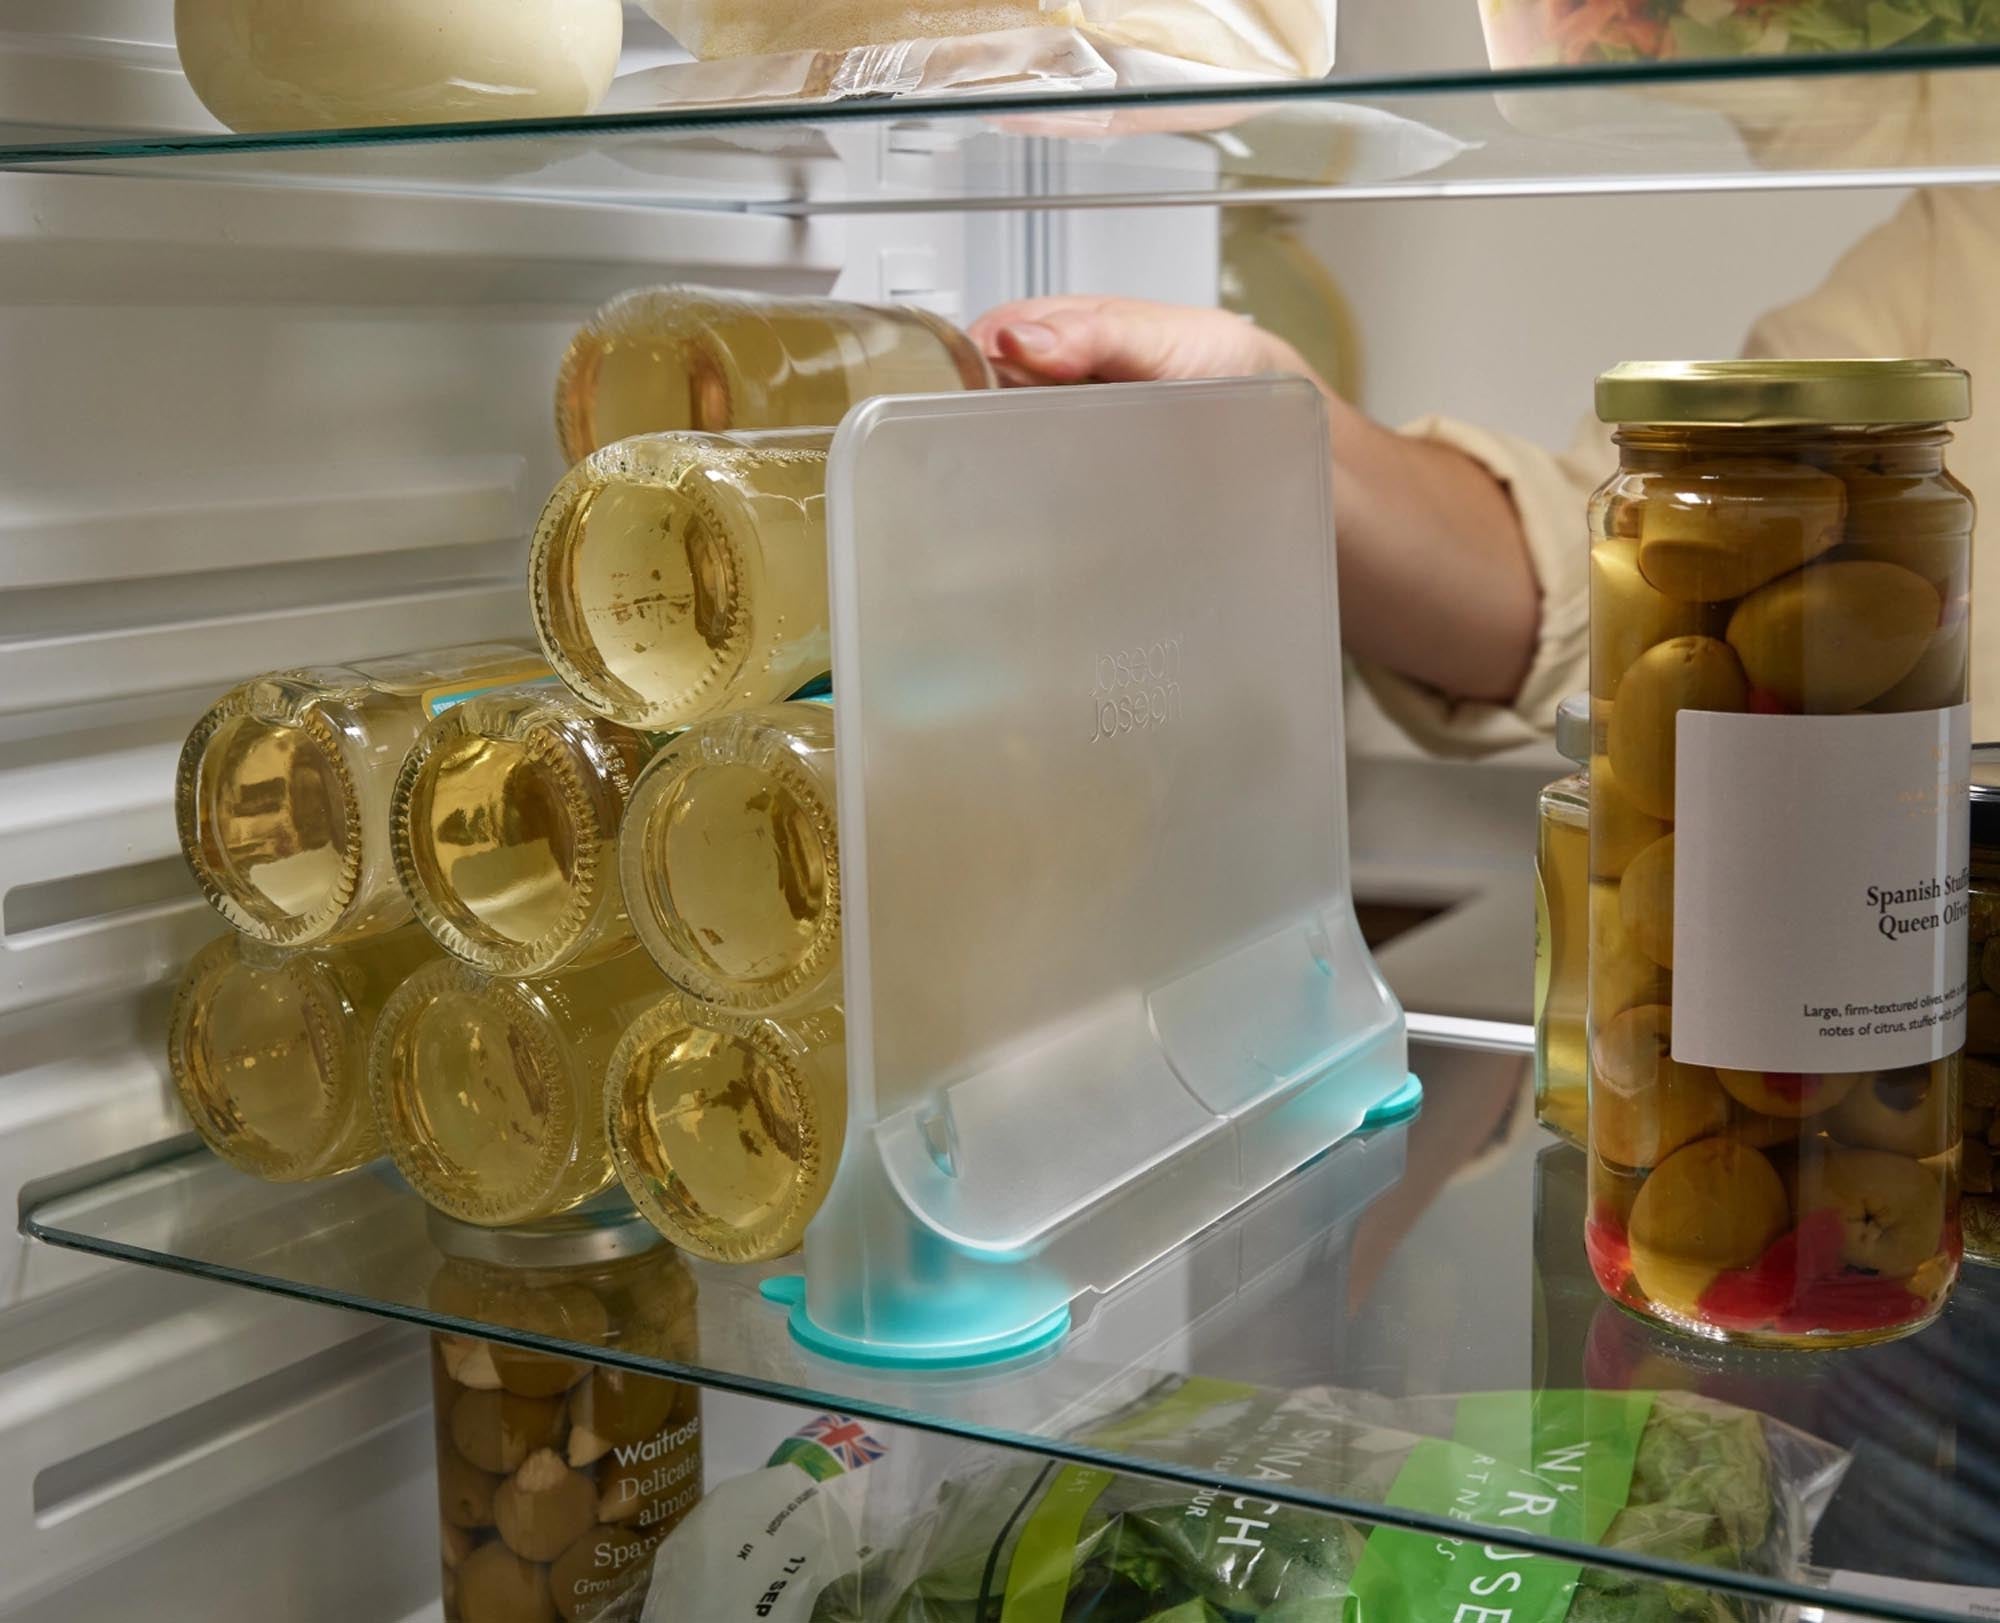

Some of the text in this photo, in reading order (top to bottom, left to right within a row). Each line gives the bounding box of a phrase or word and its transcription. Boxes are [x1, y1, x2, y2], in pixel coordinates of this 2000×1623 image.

[1866, 878, 1941, 914] Spanish
[1878, 914, 1940, 941] Queen
[1803, 1003, 1842, 1020] Large,
[1844, 997, 1919, 1017] firm-textured
[1818, 1025, 1855, 1038] notes
[1858, 1022, 1873, 1036] of
[1908, 1012, 1938, 1031] stuffed
[614, 1416, 700, 1468] Waitrose
[736, 1543, 754, 1561] UK
[755, 1580, 788, 1618] SEP
